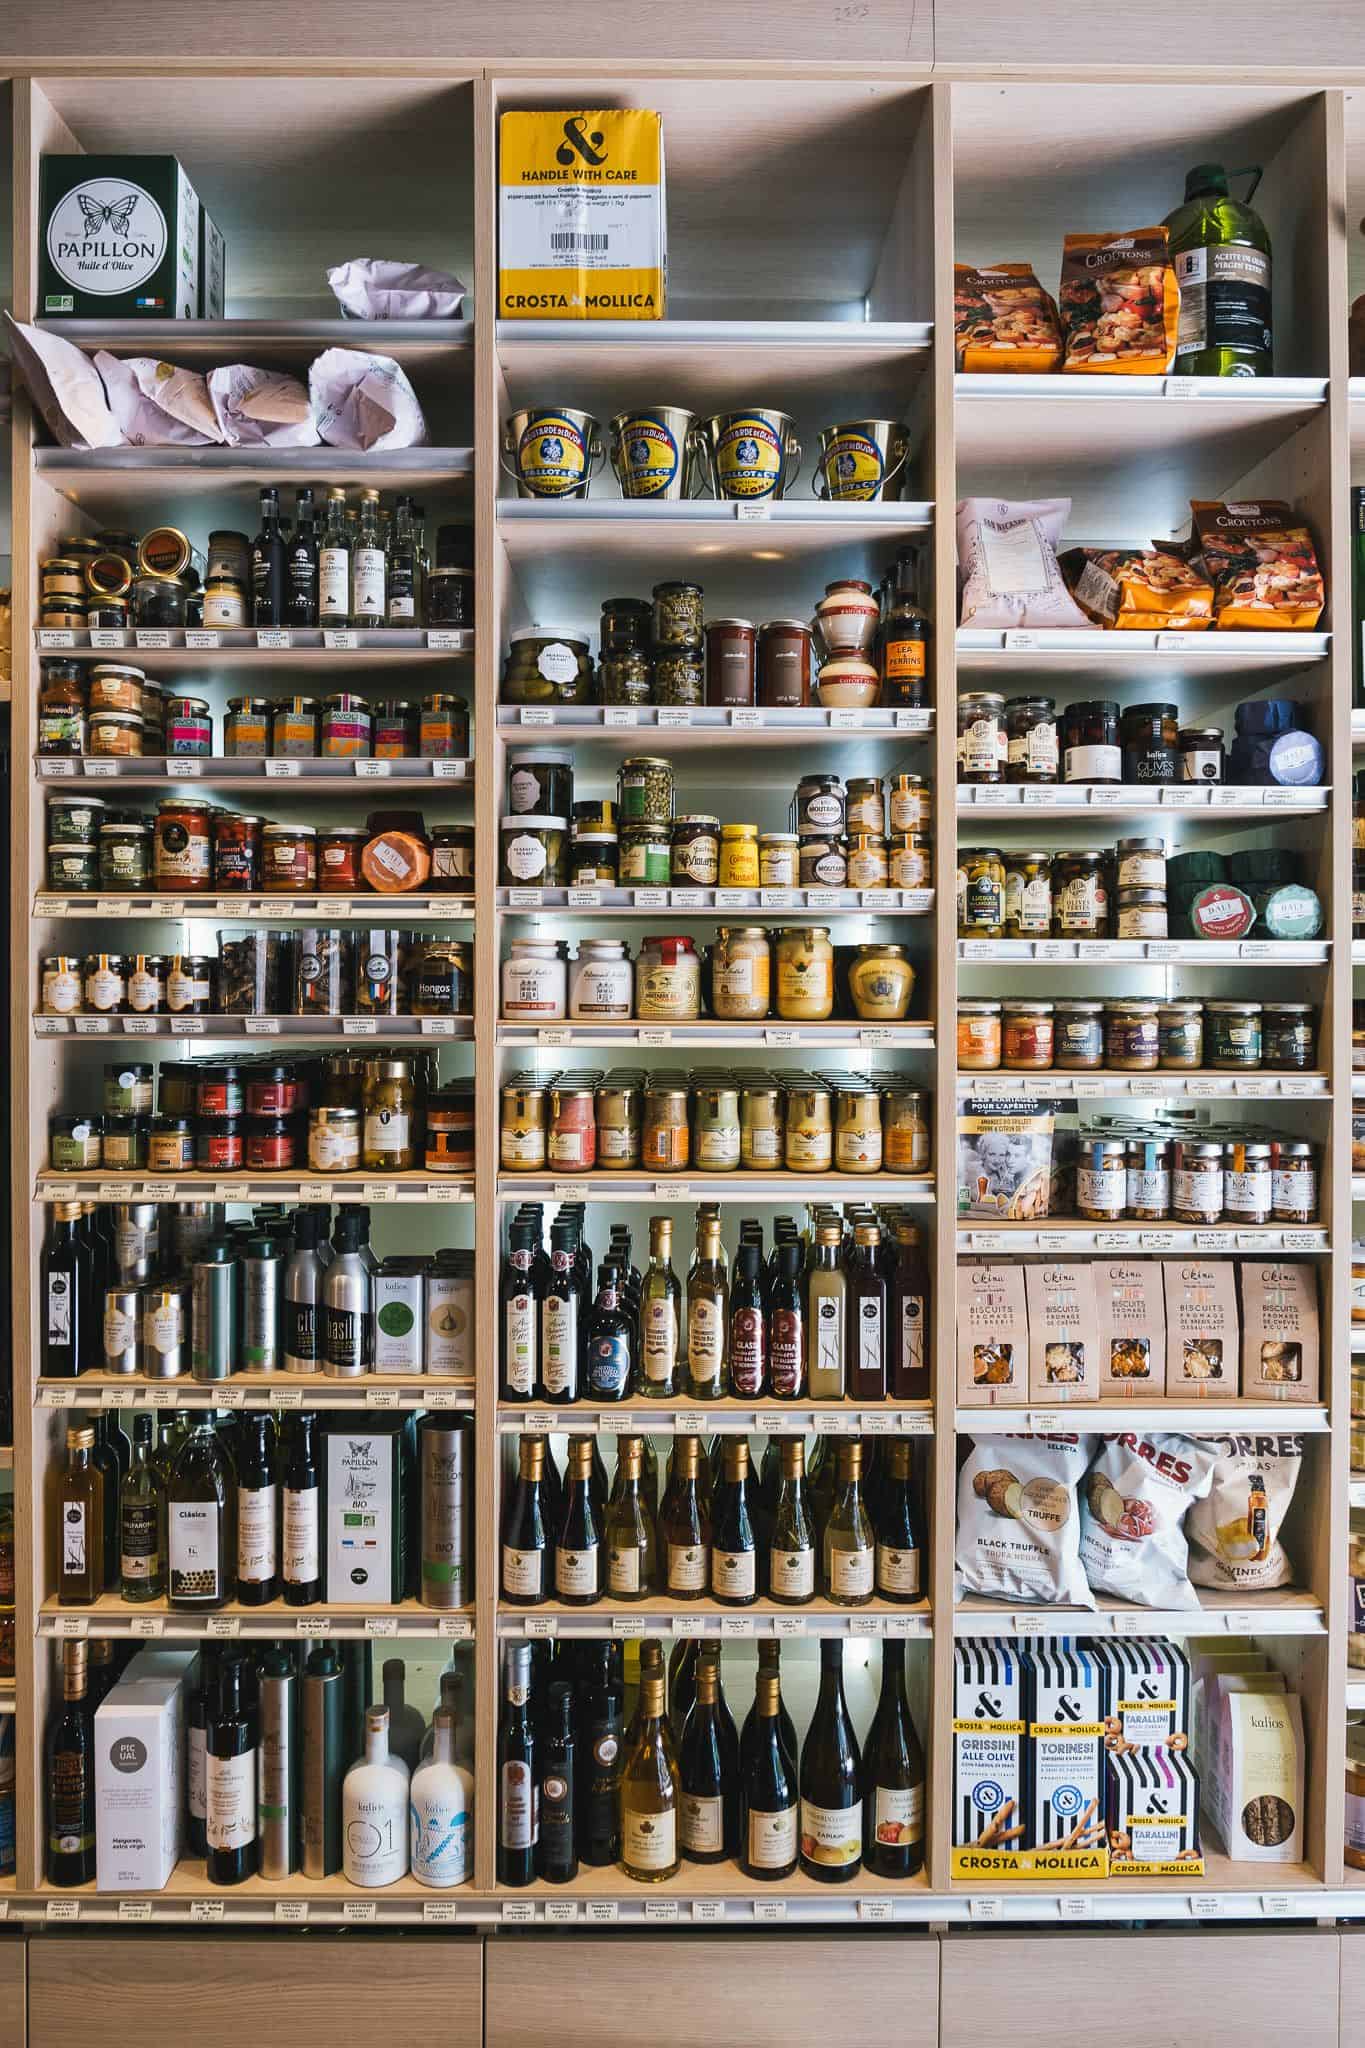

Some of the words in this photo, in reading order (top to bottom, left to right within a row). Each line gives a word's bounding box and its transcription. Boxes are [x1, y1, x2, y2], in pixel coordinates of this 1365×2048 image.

[521, 170, 569, 181] HANDLE
[573, 169, 602, 180] WITH
[605, 169, 638, 180] CARE
[58, 242, 155, 258] PAPILLON
[78, 260, 100, 270] Huile
[505, 294, 568, 308] CROSTA
[585, 294, 655, 308] MOLLICA
[889, 657, 921, 665] PERRINS
[1137, 760, 1175, 770] OLIVES
[418, 983, 450, 995] Hongos
[1180, 1304, 1225, 1312] BISCUITS
[1263, 1304, 1298, 1312] BISCUITS
[342, 1459, 378, 1467] PAPILLON
[352, 1500, 368, 1509] BIO
[1028, 1509, 1062, 1522] TRUFFE
[977, 1538, 1008, 1549] BLACK
[1011, 1542, 1050, 1555] TRUFFLE
[1137, 1679, 1159, 1700] &
[975, 1691, 1004, 1719] &
[1054, 1694, 1081, 1722] &
[1125, 1715, 1169, 1724] TARALLINI
[953, 1722, 985, 1731] CROSTA
[990, 1723, 1023, 1732] MOLLICA
[1033, 1726, 1063, 1735] CROSTA
[1069, 1726, 1102, 1735] MOLLICA
[120, 1744, 136, 1752] PIC
[961, 1739, 1015, 1751] GRISSINI
[119, 1752, 137, 1760] UAL
[962, 1752, 985, 1761] ALLE
[986, 1752, 1015, 1761] OLIVE
[1146, 1793, 1169, 1815] &
[1134, 1830, 1179, 1840] TARALLINI
[959, 1856, 1019, 1870] CROSTA
[1034, 1856, 1100, 1870] MOLLICA
[1115, 1864, 1152, 1873] CROSTA
[1160, 1864, 1201, 1873] MOLLICA
